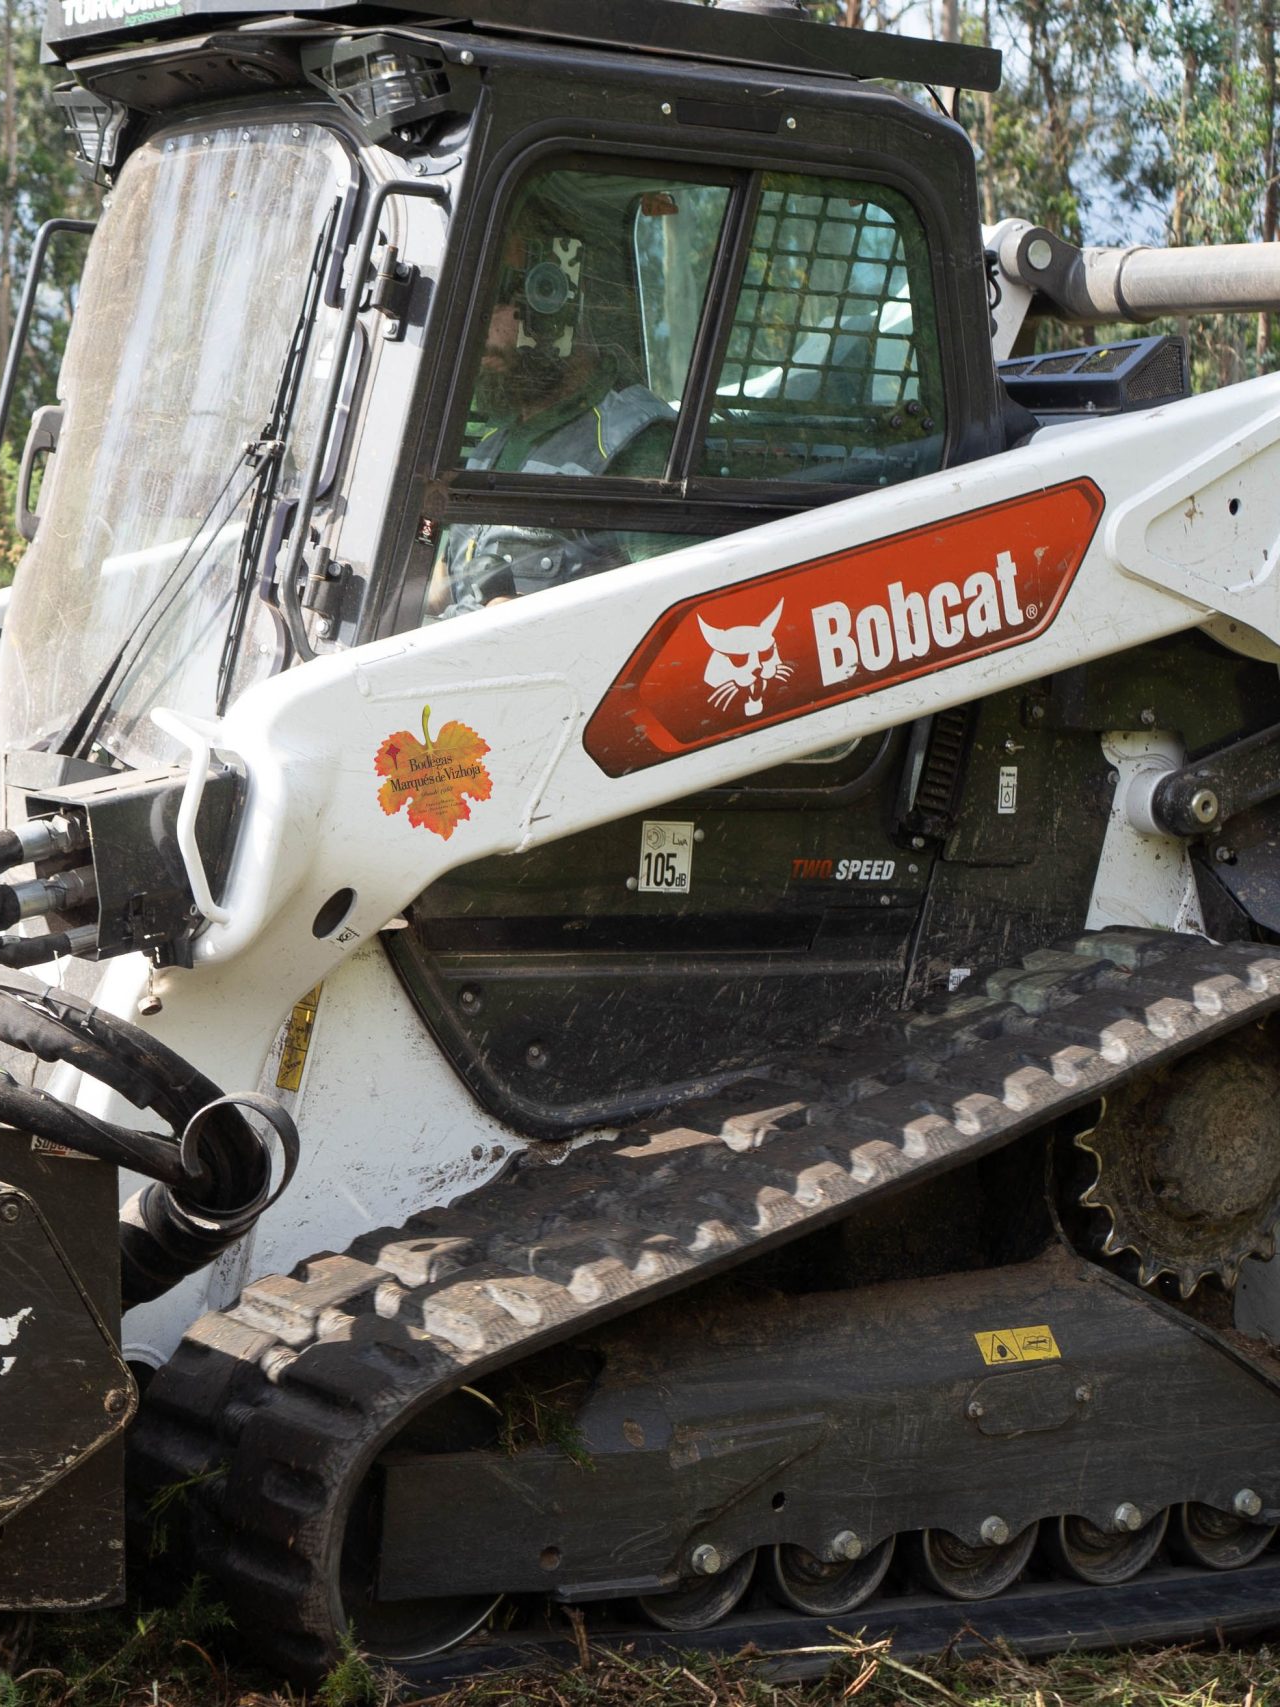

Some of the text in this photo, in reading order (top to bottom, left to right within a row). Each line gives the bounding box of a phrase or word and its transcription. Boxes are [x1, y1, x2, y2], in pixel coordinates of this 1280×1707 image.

[61, 0, 181, 26] TURQU
[811, 550, 1024, 687] Bobcat
[409, 754, 453, 772] Bodegas
[390, 774, 435, 792] Marqués
[435, 773, 446, 783] de
[443, 764, 481, 780] Vizhoja
[791, 858, 896, 880] TWO SPEED
